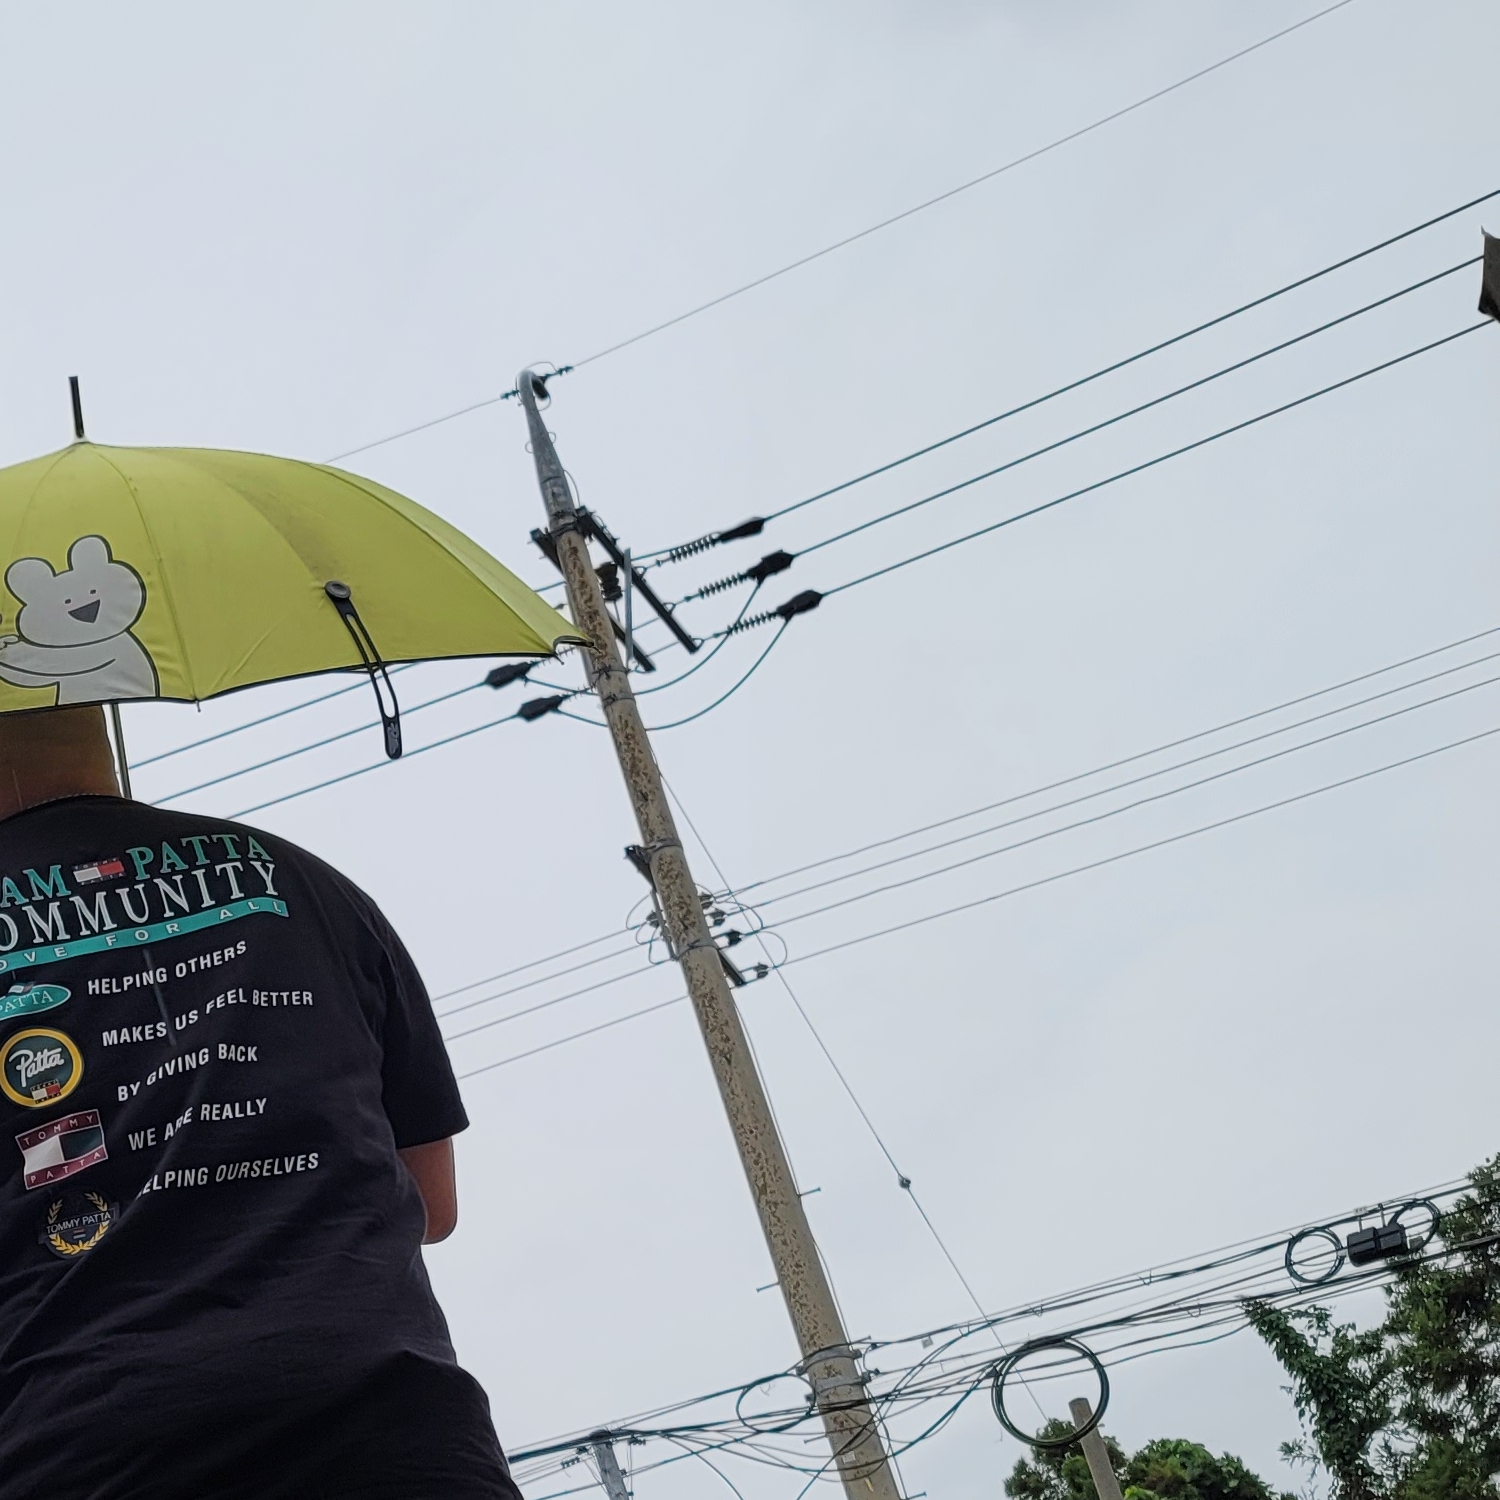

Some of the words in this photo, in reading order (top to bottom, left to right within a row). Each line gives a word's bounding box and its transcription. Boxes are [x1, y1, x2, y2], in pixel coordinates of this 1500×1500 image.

[125, 834, 273, 881] PATTA
[105, 923, 181, 946] FOR
[219, 901, 282, 920] ALL
[87, 967, 167, 995] HELPING
[175, 940, 247, 978] OTHERS
[102, 1021, 167, 1047] MAKES
[175, 1009, 198, 1031] US
[205, 987, 248, 1015] FEEL
[252, 989, 313, 1007] BETTER
[8, 1047, 65, 1088] Patta
[117, 1081, 141, 1102] BY
[146, 1047, 209, 1086] GIVING
[218, 1043, 258, 1062] BACK
[23, 1115, 94, 1146] TOMMY
[128, 1127, 157, 1151] WE
[164, 1106, 193, 1141] ARE
[200, 1097, 267, 1121] REALLY
[30, 1151, 101, 1184] PATTA
[134, 1166, 209, 1200] ELPING
[215, 1152, 319, 1182] OURSELVES
[46, 1218, 81, 1234] TOMMY
[82, 1211, 112, 1226] PATTA
